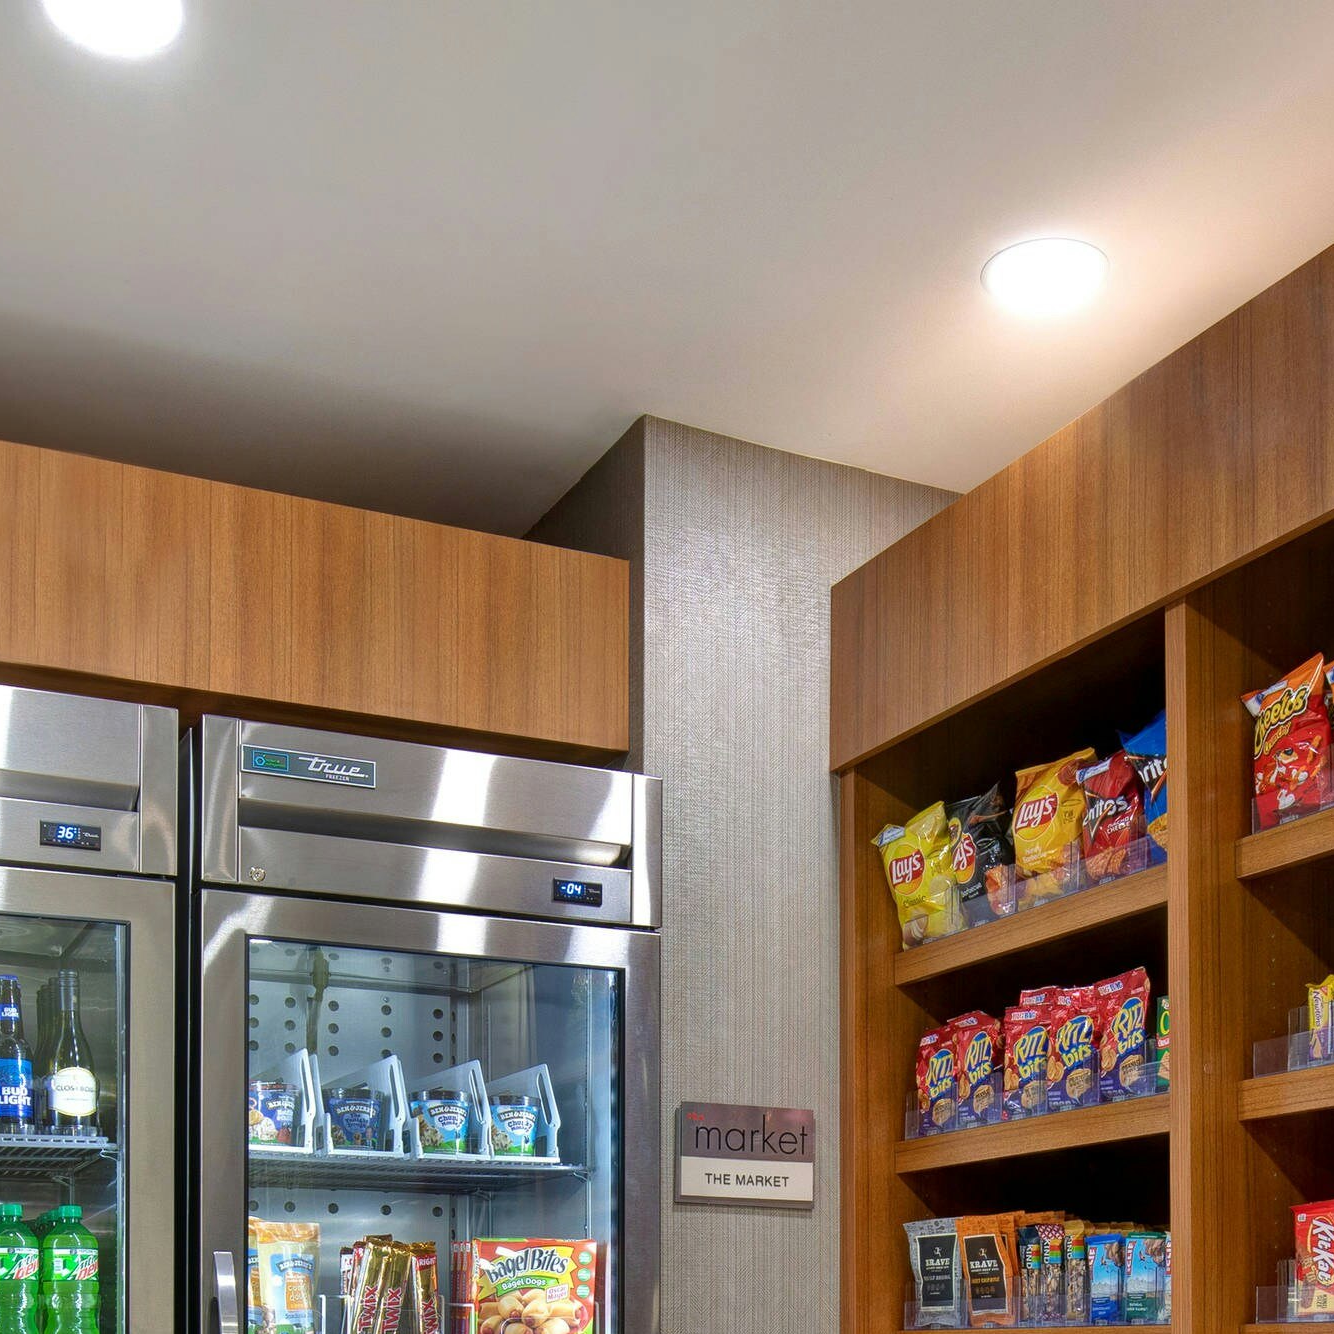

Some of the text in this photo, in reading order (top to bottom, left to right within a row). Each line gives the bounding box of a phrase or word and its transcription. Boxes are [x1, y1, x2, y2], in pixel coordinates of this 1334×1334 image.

[1017, 795, 1057, 830] Lay's
[57, 826, 75, 839] 36
[892, 850, 924, 885] Lay's
[1057, 1020, 1094, 1051] RITZ
[1113, 1003, 1145, 1037] RITZ
[966, 1037, 992, 1069] RITZ
[1015, 1033, 1048, 1064] RITZ
[927, 1054, 955, 1085] RITZ
[1, 1087, 28, 1096] BUD
[695, 1114, 808, 1155] market
[705, 1173, 789, 1187] THE MARKET
[487, 1248, 569, 1283] Bagel Bites
[926, 1258, 950, 1267] KRAVE
[970, 1260, 998, 1269] KRAVE
[501, 1277, 547, 1291] Bagel Dogs
[357, 1286, 378, 1332] TWIX
[380, 1288, 402, 1334] TWIX
